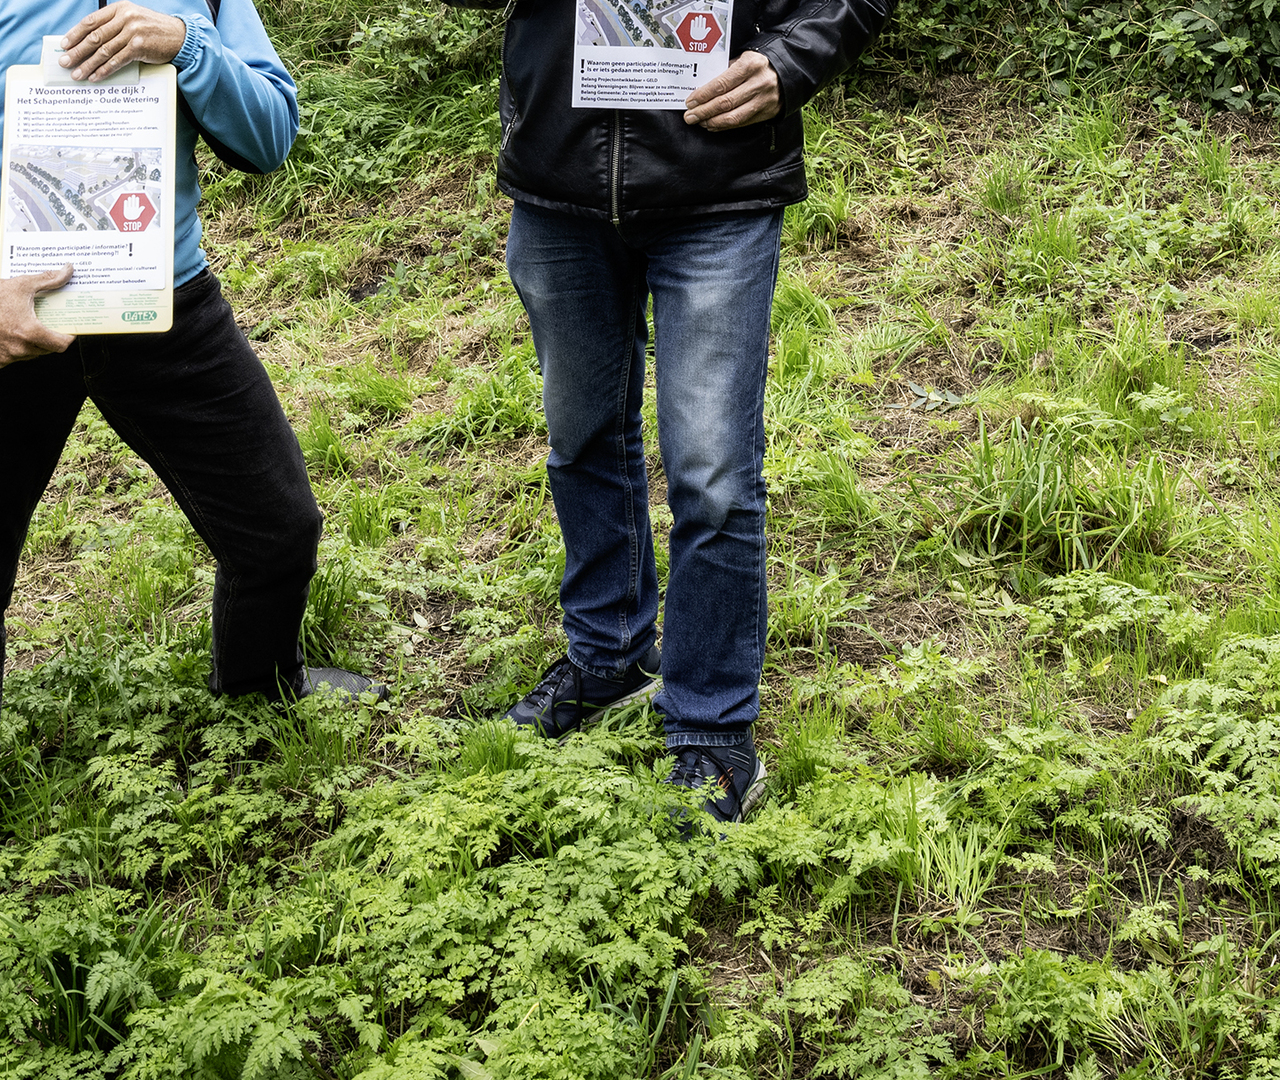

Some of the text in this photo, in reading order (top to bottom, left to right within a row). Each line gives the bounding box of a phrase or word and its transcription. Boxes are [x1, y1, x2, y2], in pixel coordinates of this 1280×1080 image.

[689, 42, 707, 52] STOP
[581, 59, 585, 73] !
[693, 63, 697, 77] !
[93, 88, 105, 96] op
[121, 87, 138, 95] dijk
[33, 97, 93, 106] Schapenlandje
[123, 95, 159, 104] Wetering
[123, 221, 142, 231] STOP
[10, 245, 14, 259] !
[129, 243, 133, 257] !
[125, 311, 154, 321] DATEX
